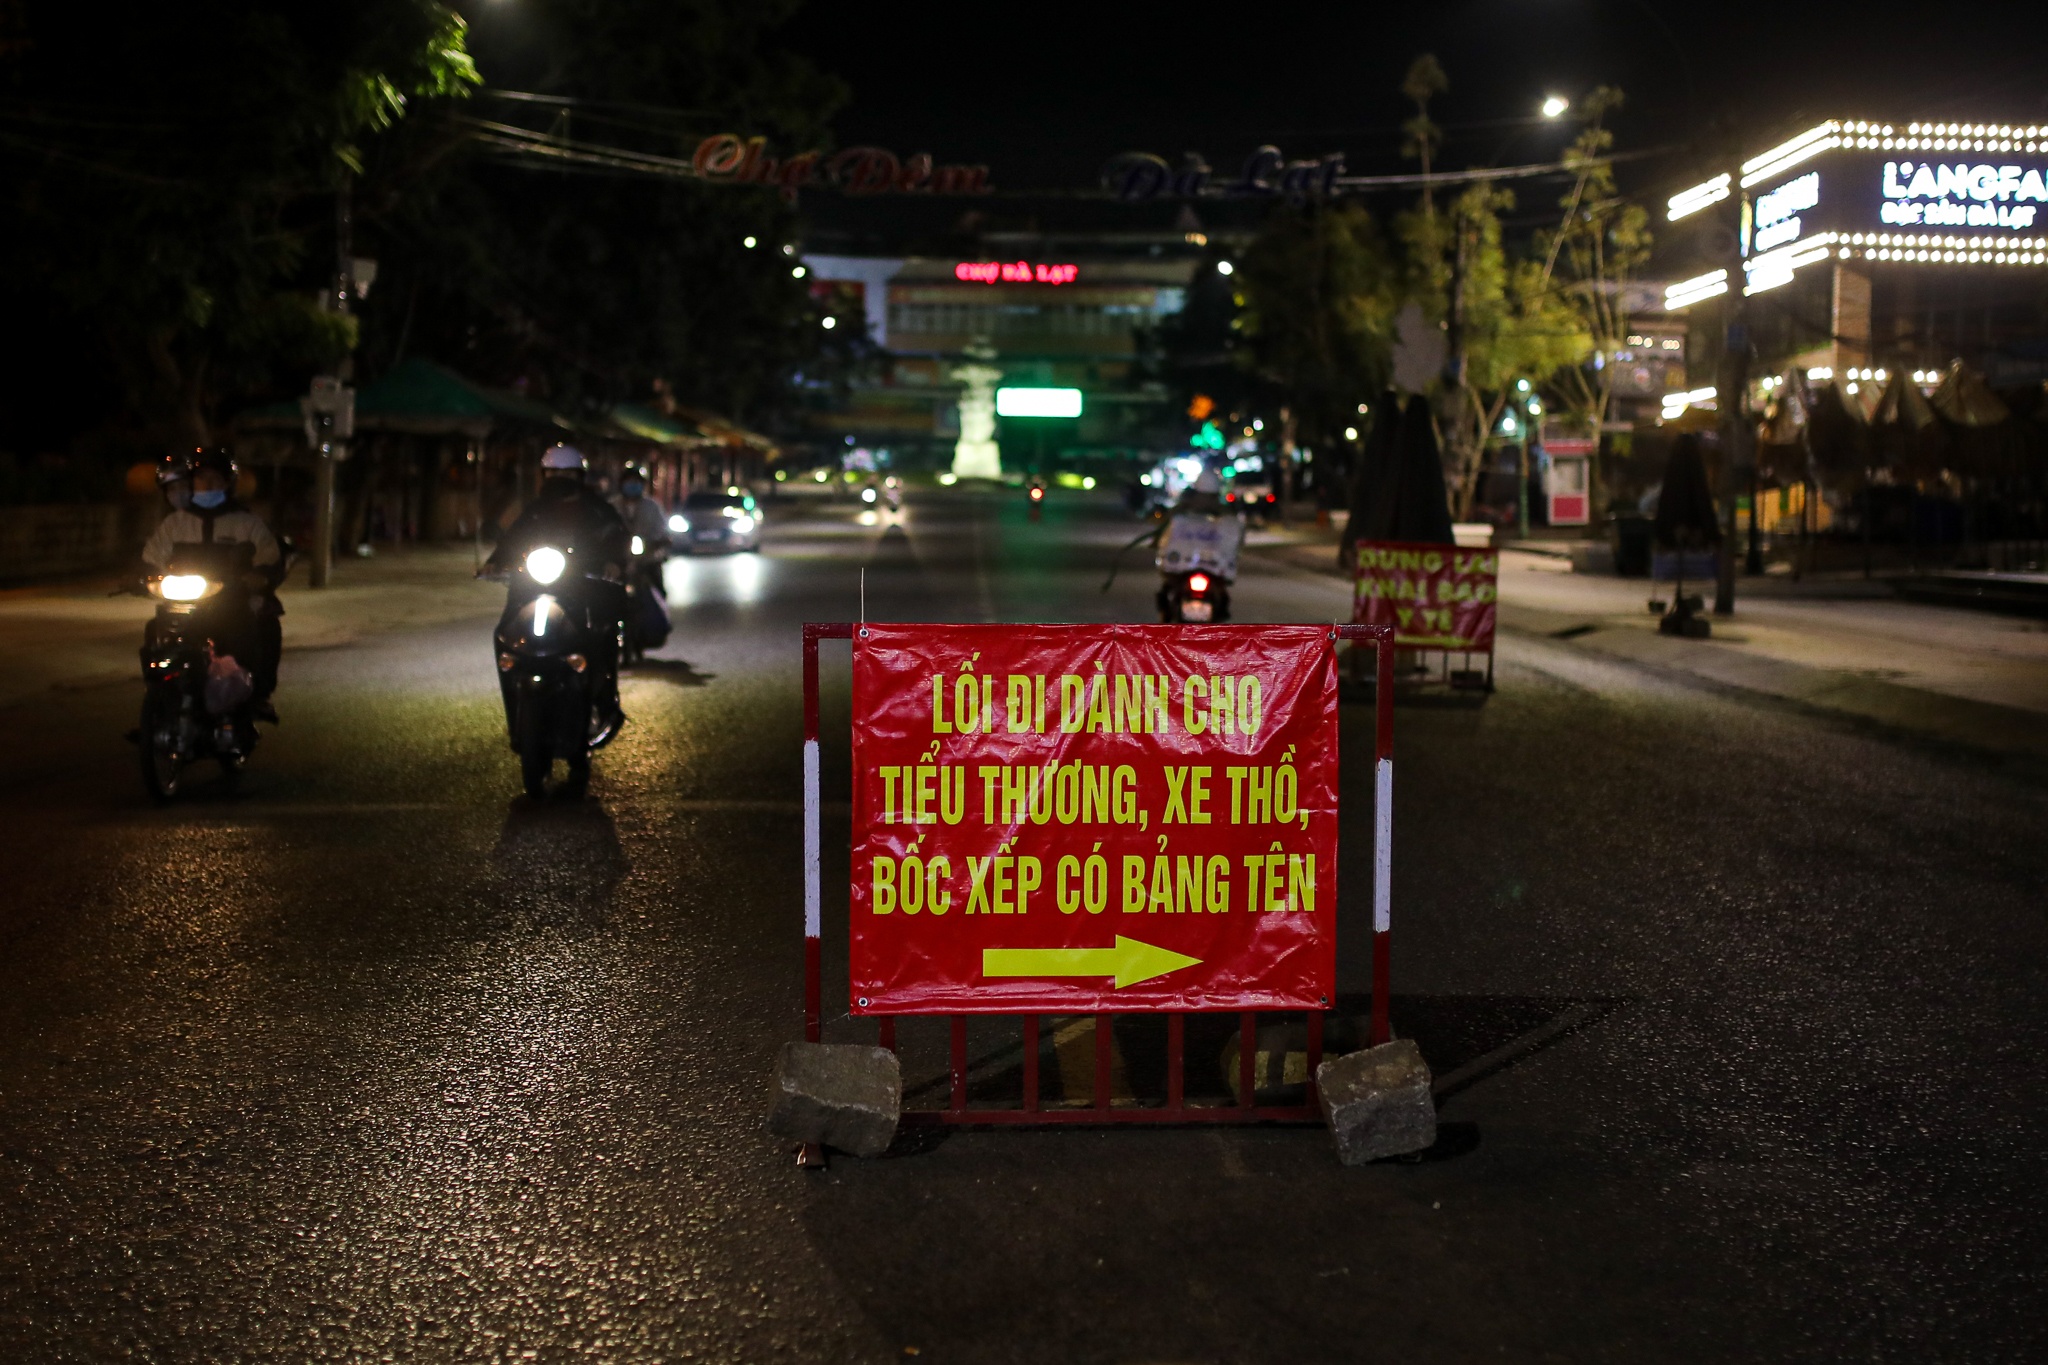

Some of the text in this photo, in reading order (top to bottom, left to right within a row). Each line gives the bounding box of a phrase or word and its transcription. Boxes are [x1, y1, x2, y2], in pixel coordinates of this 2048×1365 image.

[1883, 161, 2048, 202] L'ANGFA
[933, 652, 1262, 735] LỐI ĐI DÀNH CHO
[880, 740, 1309, 831] TIỂU THƯƠNG, XE THỒ,
[873, 834, 1316, 915] BỐC XẾP CÓ BẢNG TÊN
